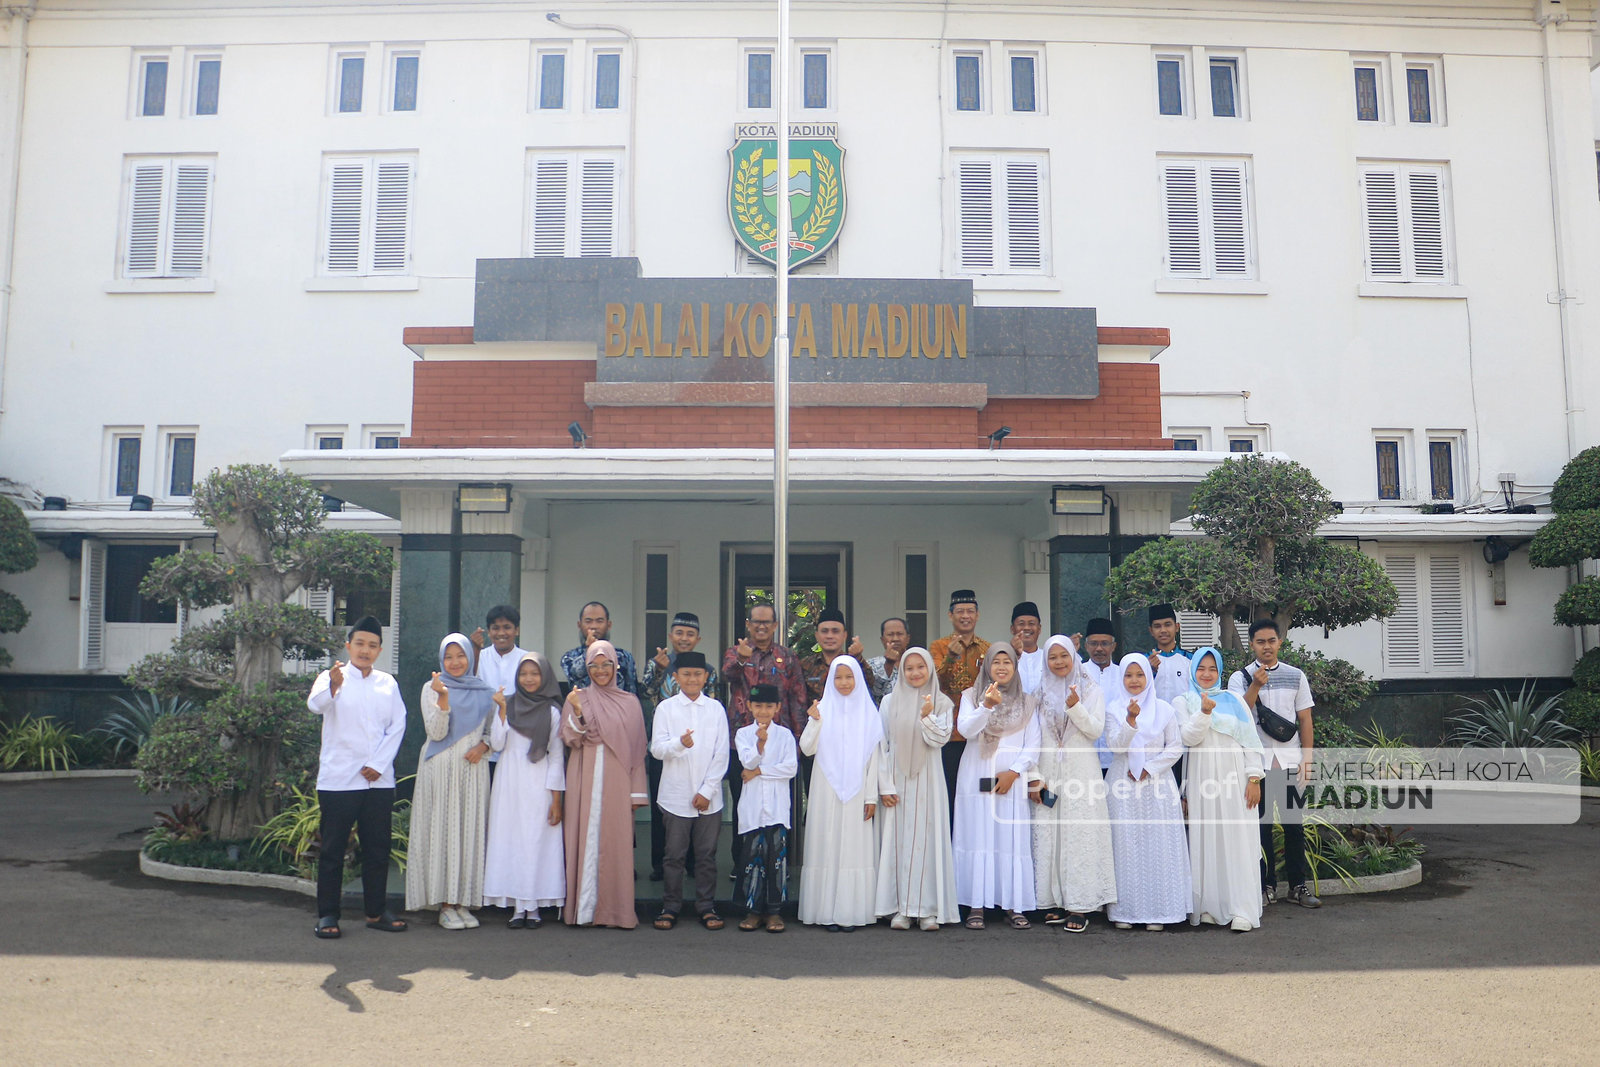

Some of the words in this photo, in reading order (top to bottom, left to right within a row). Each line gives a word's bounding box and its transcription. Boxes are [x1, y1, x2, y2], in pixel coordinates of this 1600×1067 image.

[738, 126, 776, 136] KOTA
[788, 126, 836, 136] ADIUN
[604, 302, 710, 357] BALAI
[723, 302, 817, 358] KOA
[832, 303, 967, 358] MADIUN
